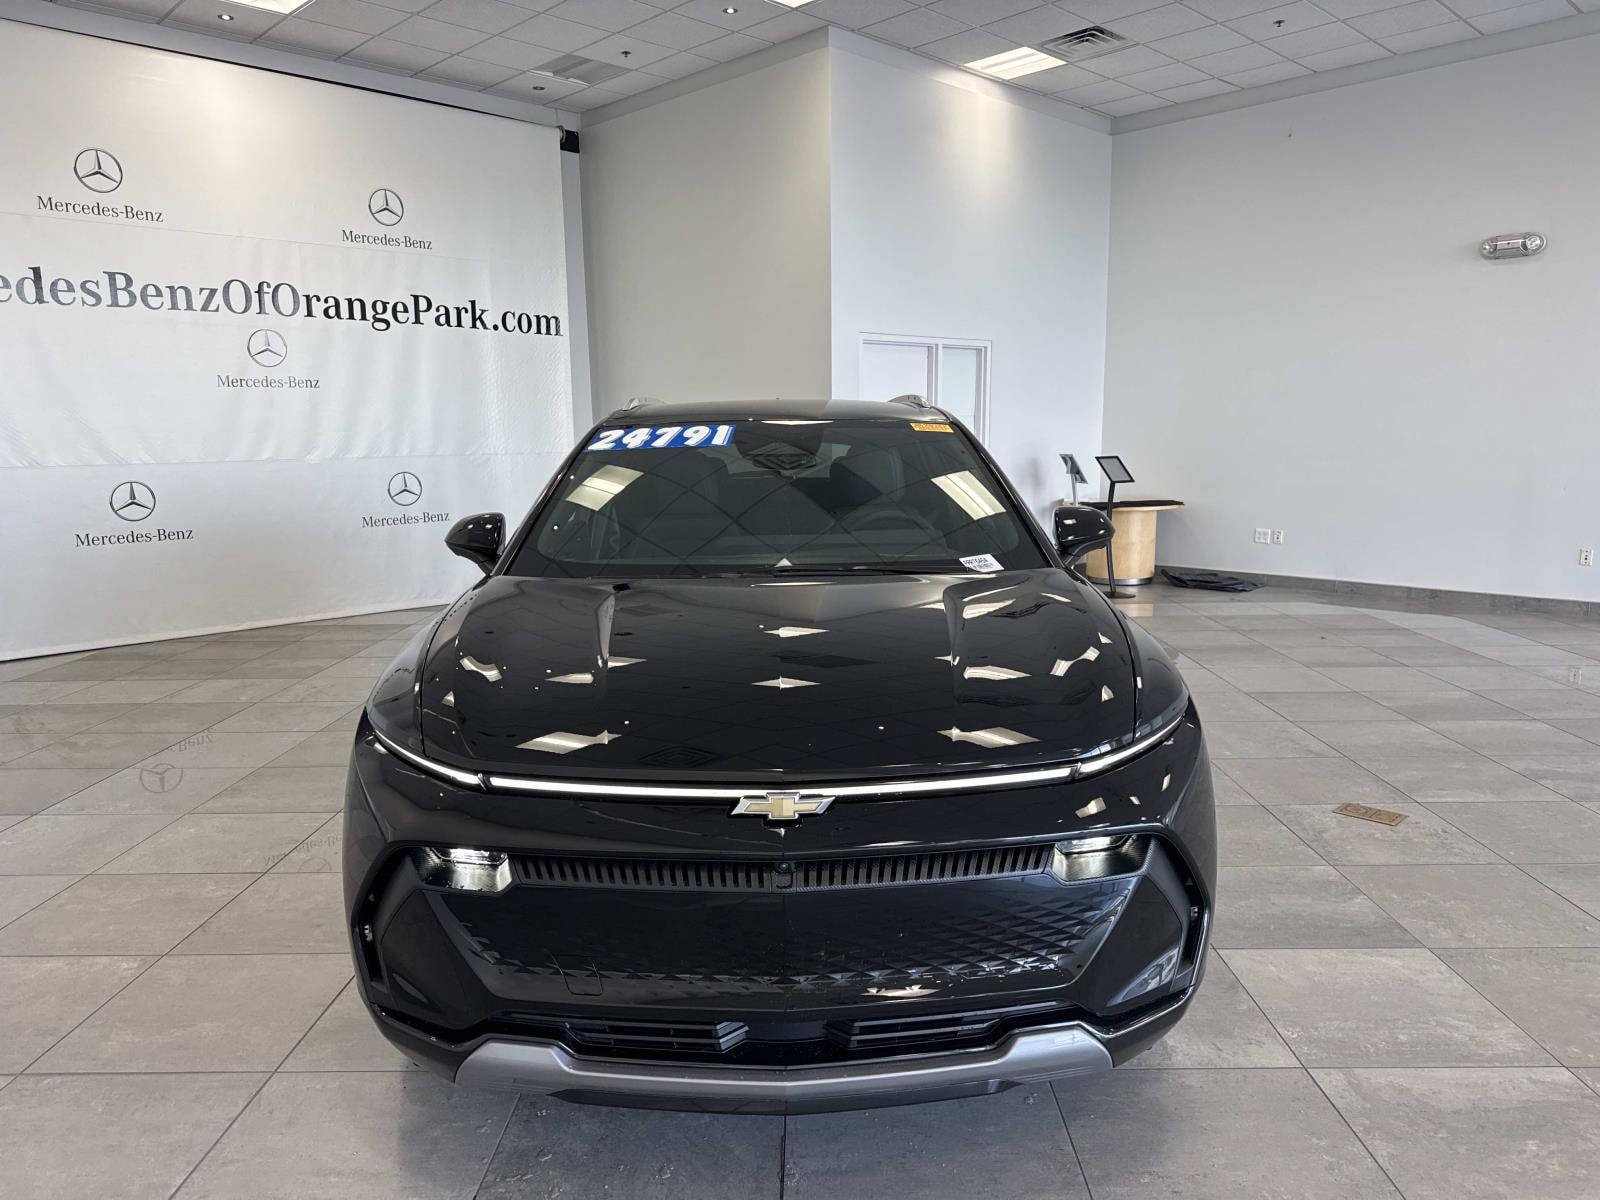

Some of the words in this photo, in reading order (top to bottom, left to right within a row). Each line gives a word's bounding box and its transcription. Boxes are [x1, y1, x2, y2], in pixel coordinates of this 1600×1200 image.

[37, 195, 164, 223] Mercedes-Benz
[341, 229, 432, 250] Mercedes-Benz
[216, 374, 320, 389] Mercedes-Benz
[587, 424, 733, 451] 24791
[361, 511, 450, 528] Mercedes-Benz
[75, 528, 194, 548] Mercedes-Benz
